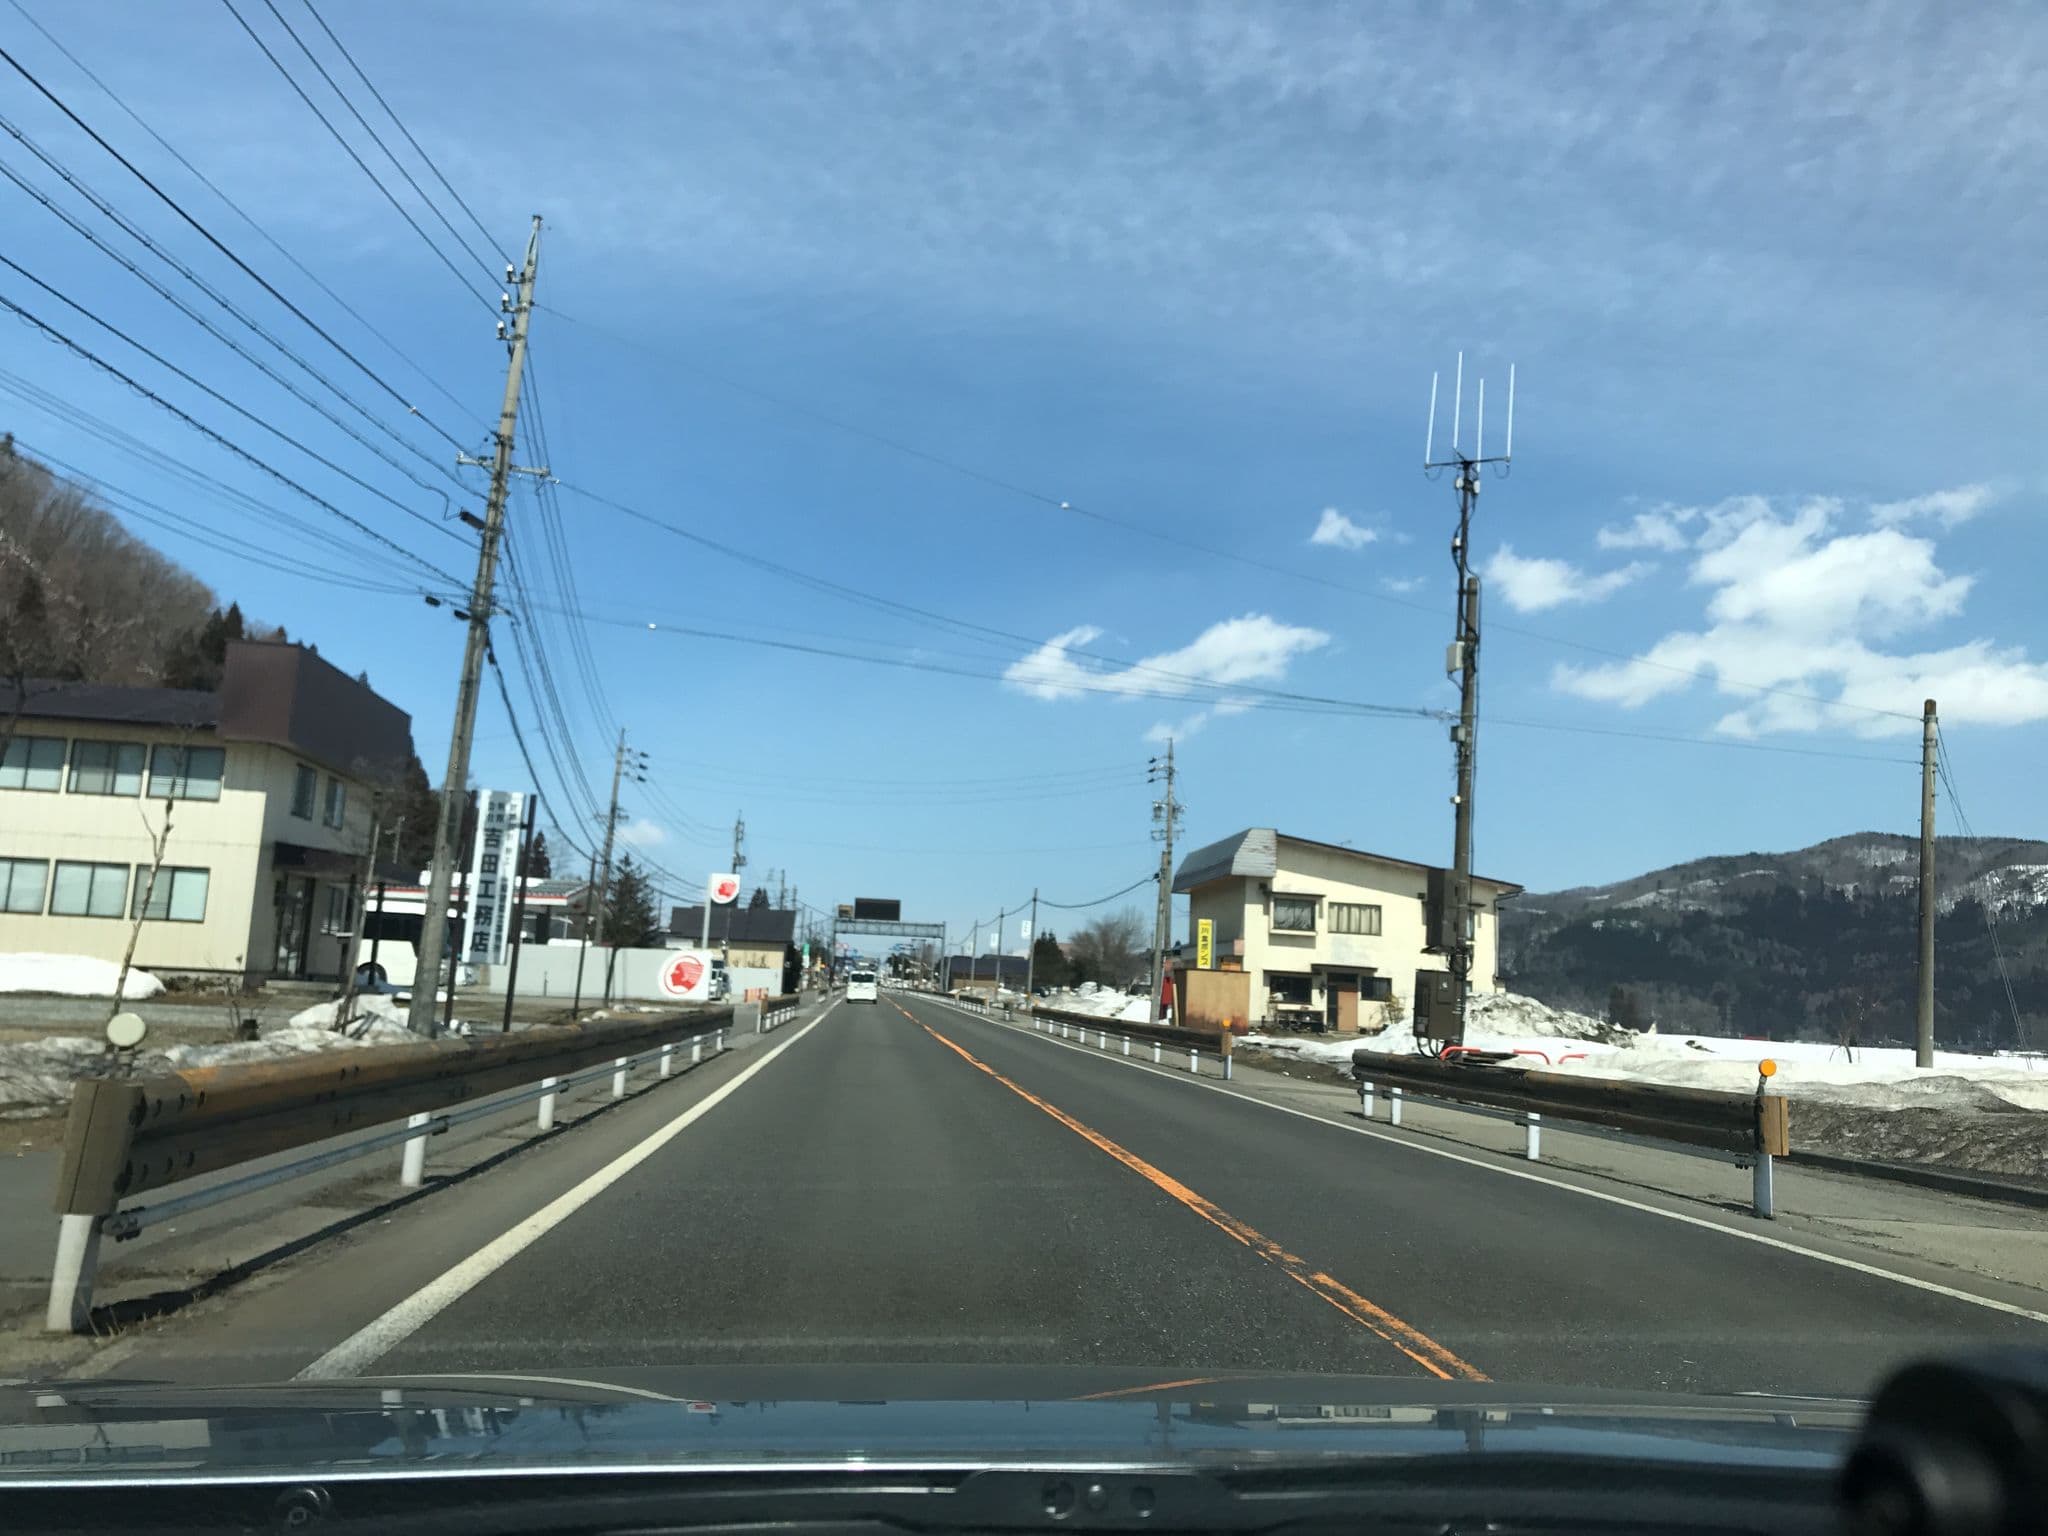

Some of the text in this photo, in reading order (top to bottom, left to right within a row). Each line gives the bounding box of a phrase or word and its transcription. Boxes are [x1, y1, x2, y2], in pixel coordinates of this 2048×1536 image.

[470, 827, 503, 952] 吉田工務店
